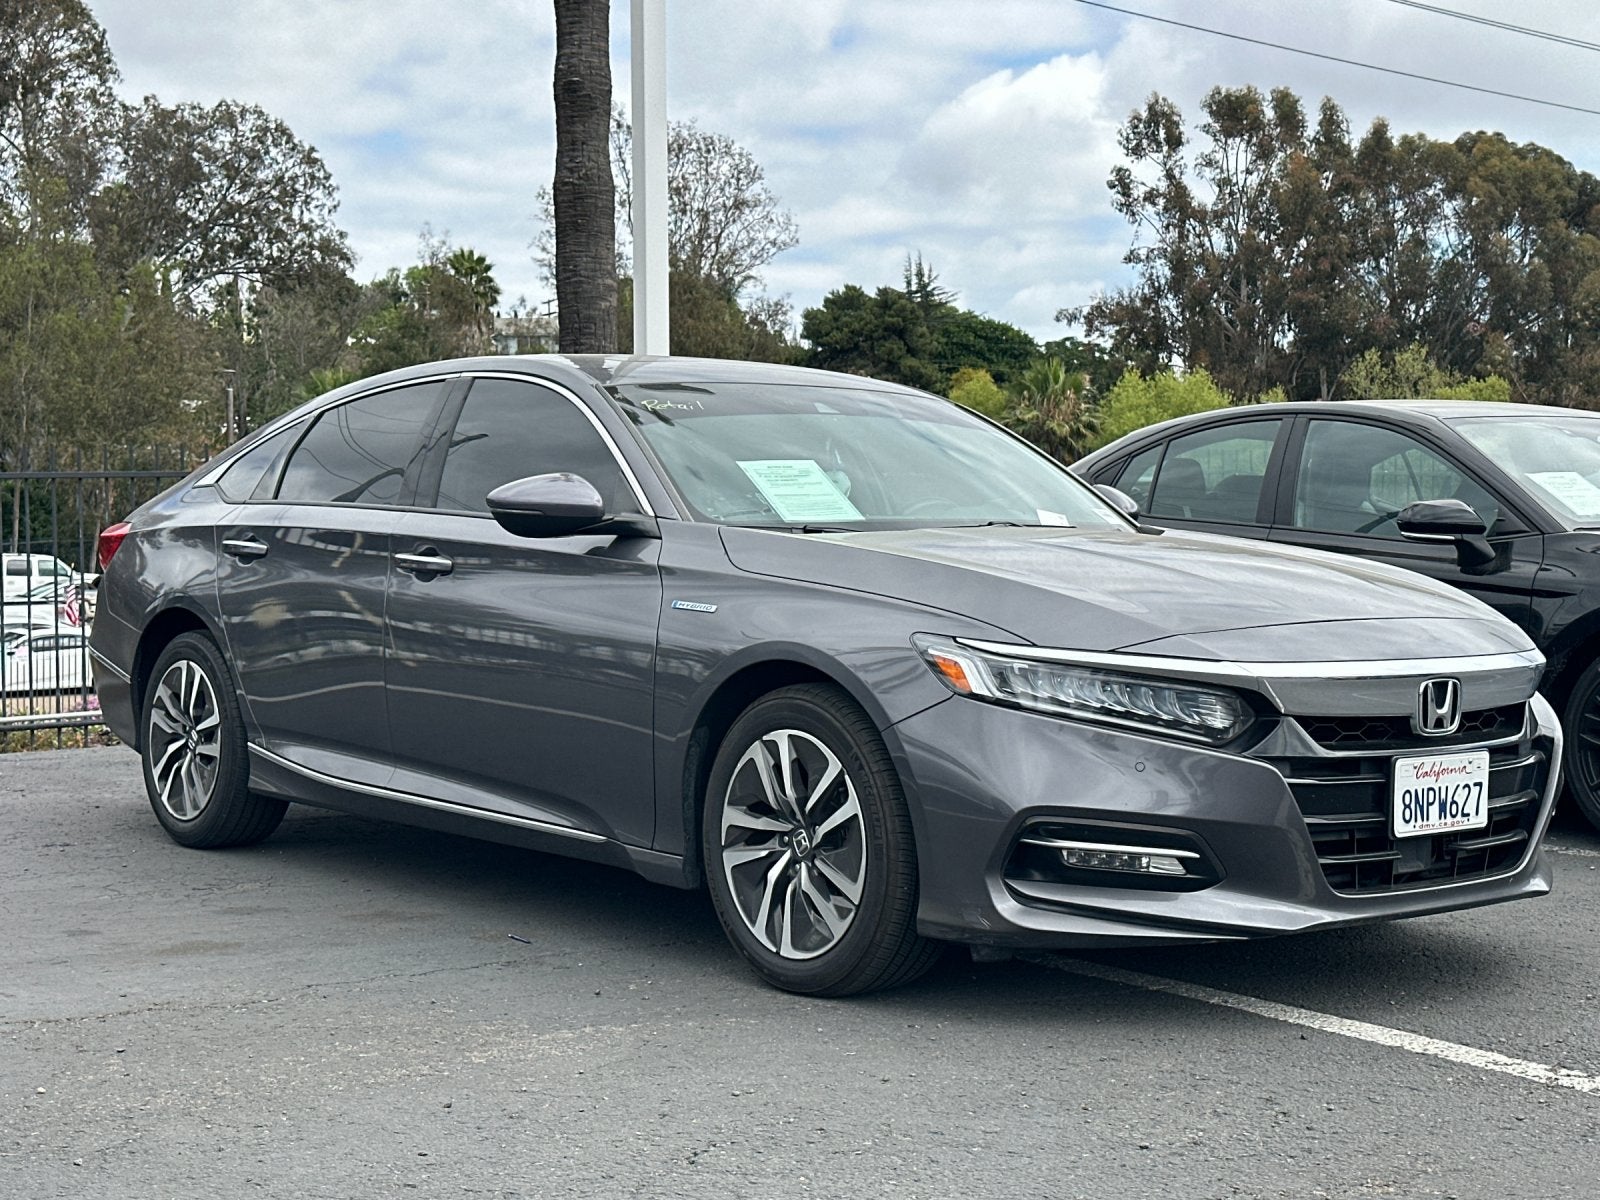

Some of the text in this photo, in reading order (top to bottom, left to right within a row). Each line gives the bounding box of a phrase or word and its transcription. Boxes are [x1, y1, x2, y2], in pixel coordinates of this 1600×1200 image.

[641, 399, 705, 411] Retail
[1415, 761, 1473, 783] California
[1401, 781, 1484, 825] 8NPW627
[1418, 819, 1466, 830] dmv.ca.gov
